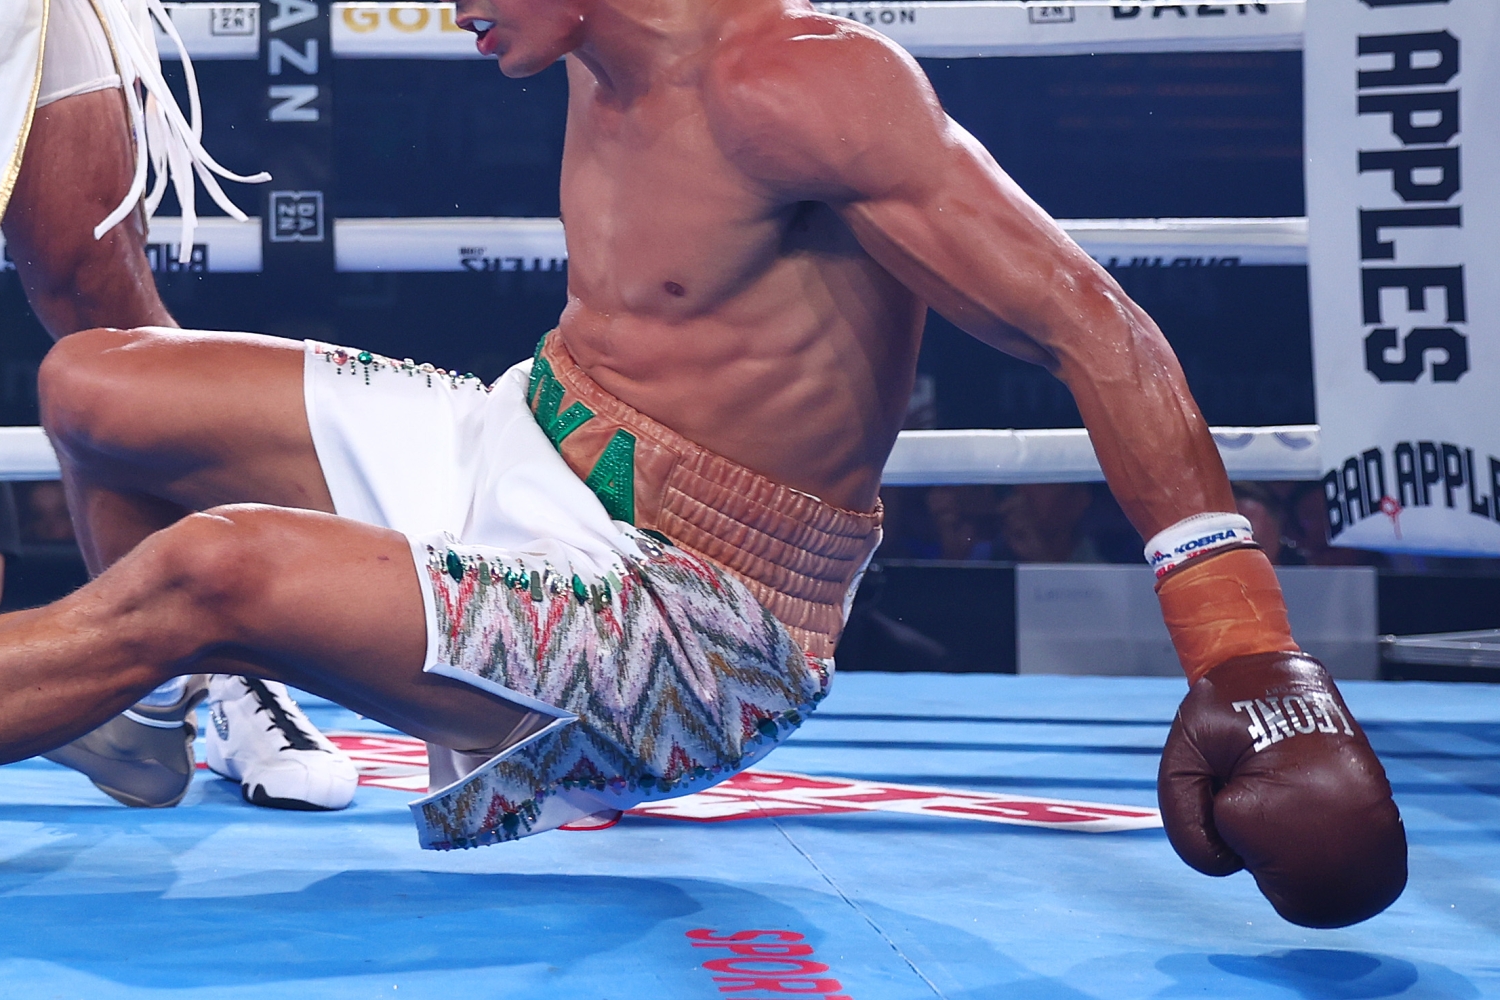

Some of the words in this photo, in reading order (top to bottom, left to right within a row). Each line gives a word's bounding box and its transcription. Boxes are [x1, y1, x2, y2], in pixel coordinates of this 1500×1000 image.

[1356, 29, 1470, 383] APPLES
[1324, 447, 1385, 540] BAD
[1174, 528, 1238, 554] KOBRA
[1231, 691, 1355, 753] LEONE
